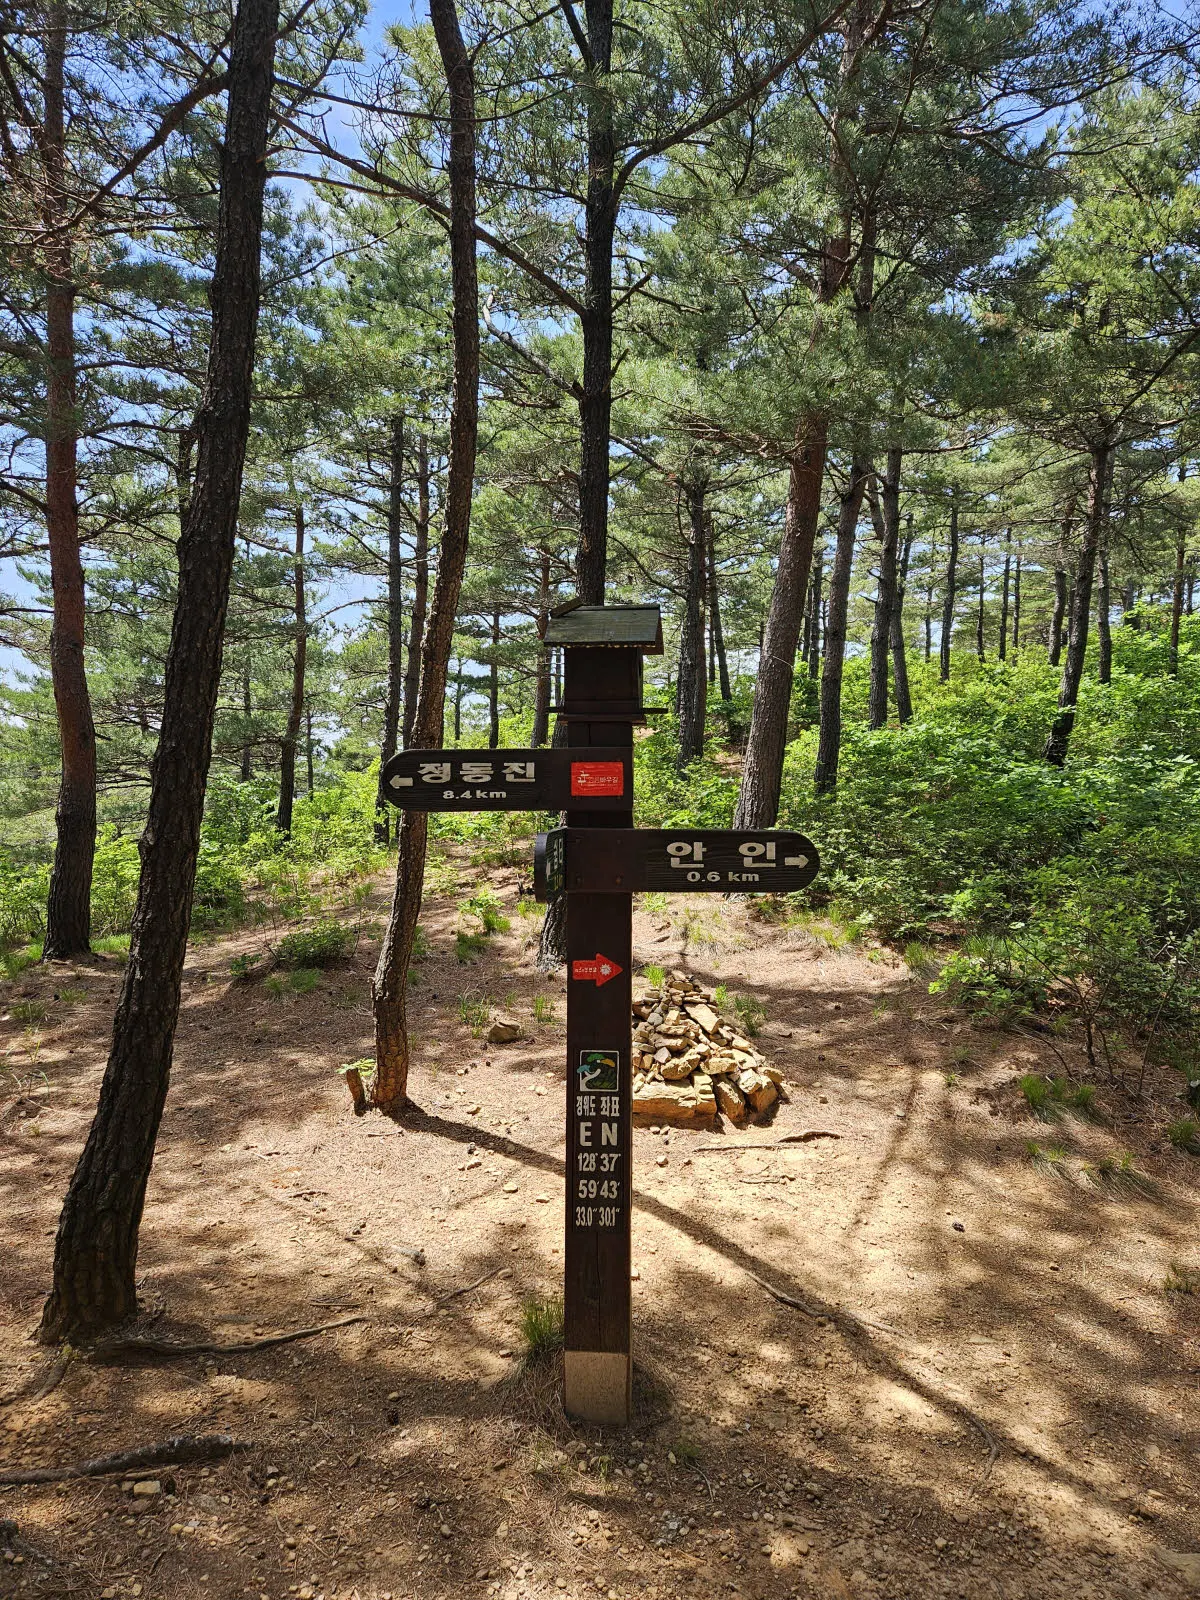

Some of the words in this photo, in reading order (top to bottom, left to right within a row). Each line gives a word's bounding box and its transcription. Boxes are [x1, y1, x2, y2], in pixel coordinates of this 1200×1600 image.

[417, 761, 536, 784] 정동진
[686, 871, 721, 882] 0.6
[728, 871, 760, 882] km
[576, 1095, 596, 1117] 경위도
[600, 1095, 620, 1117] 좌표
[580, 1121, 592, 1147] E
[601, 1122, 618, 1146] N
